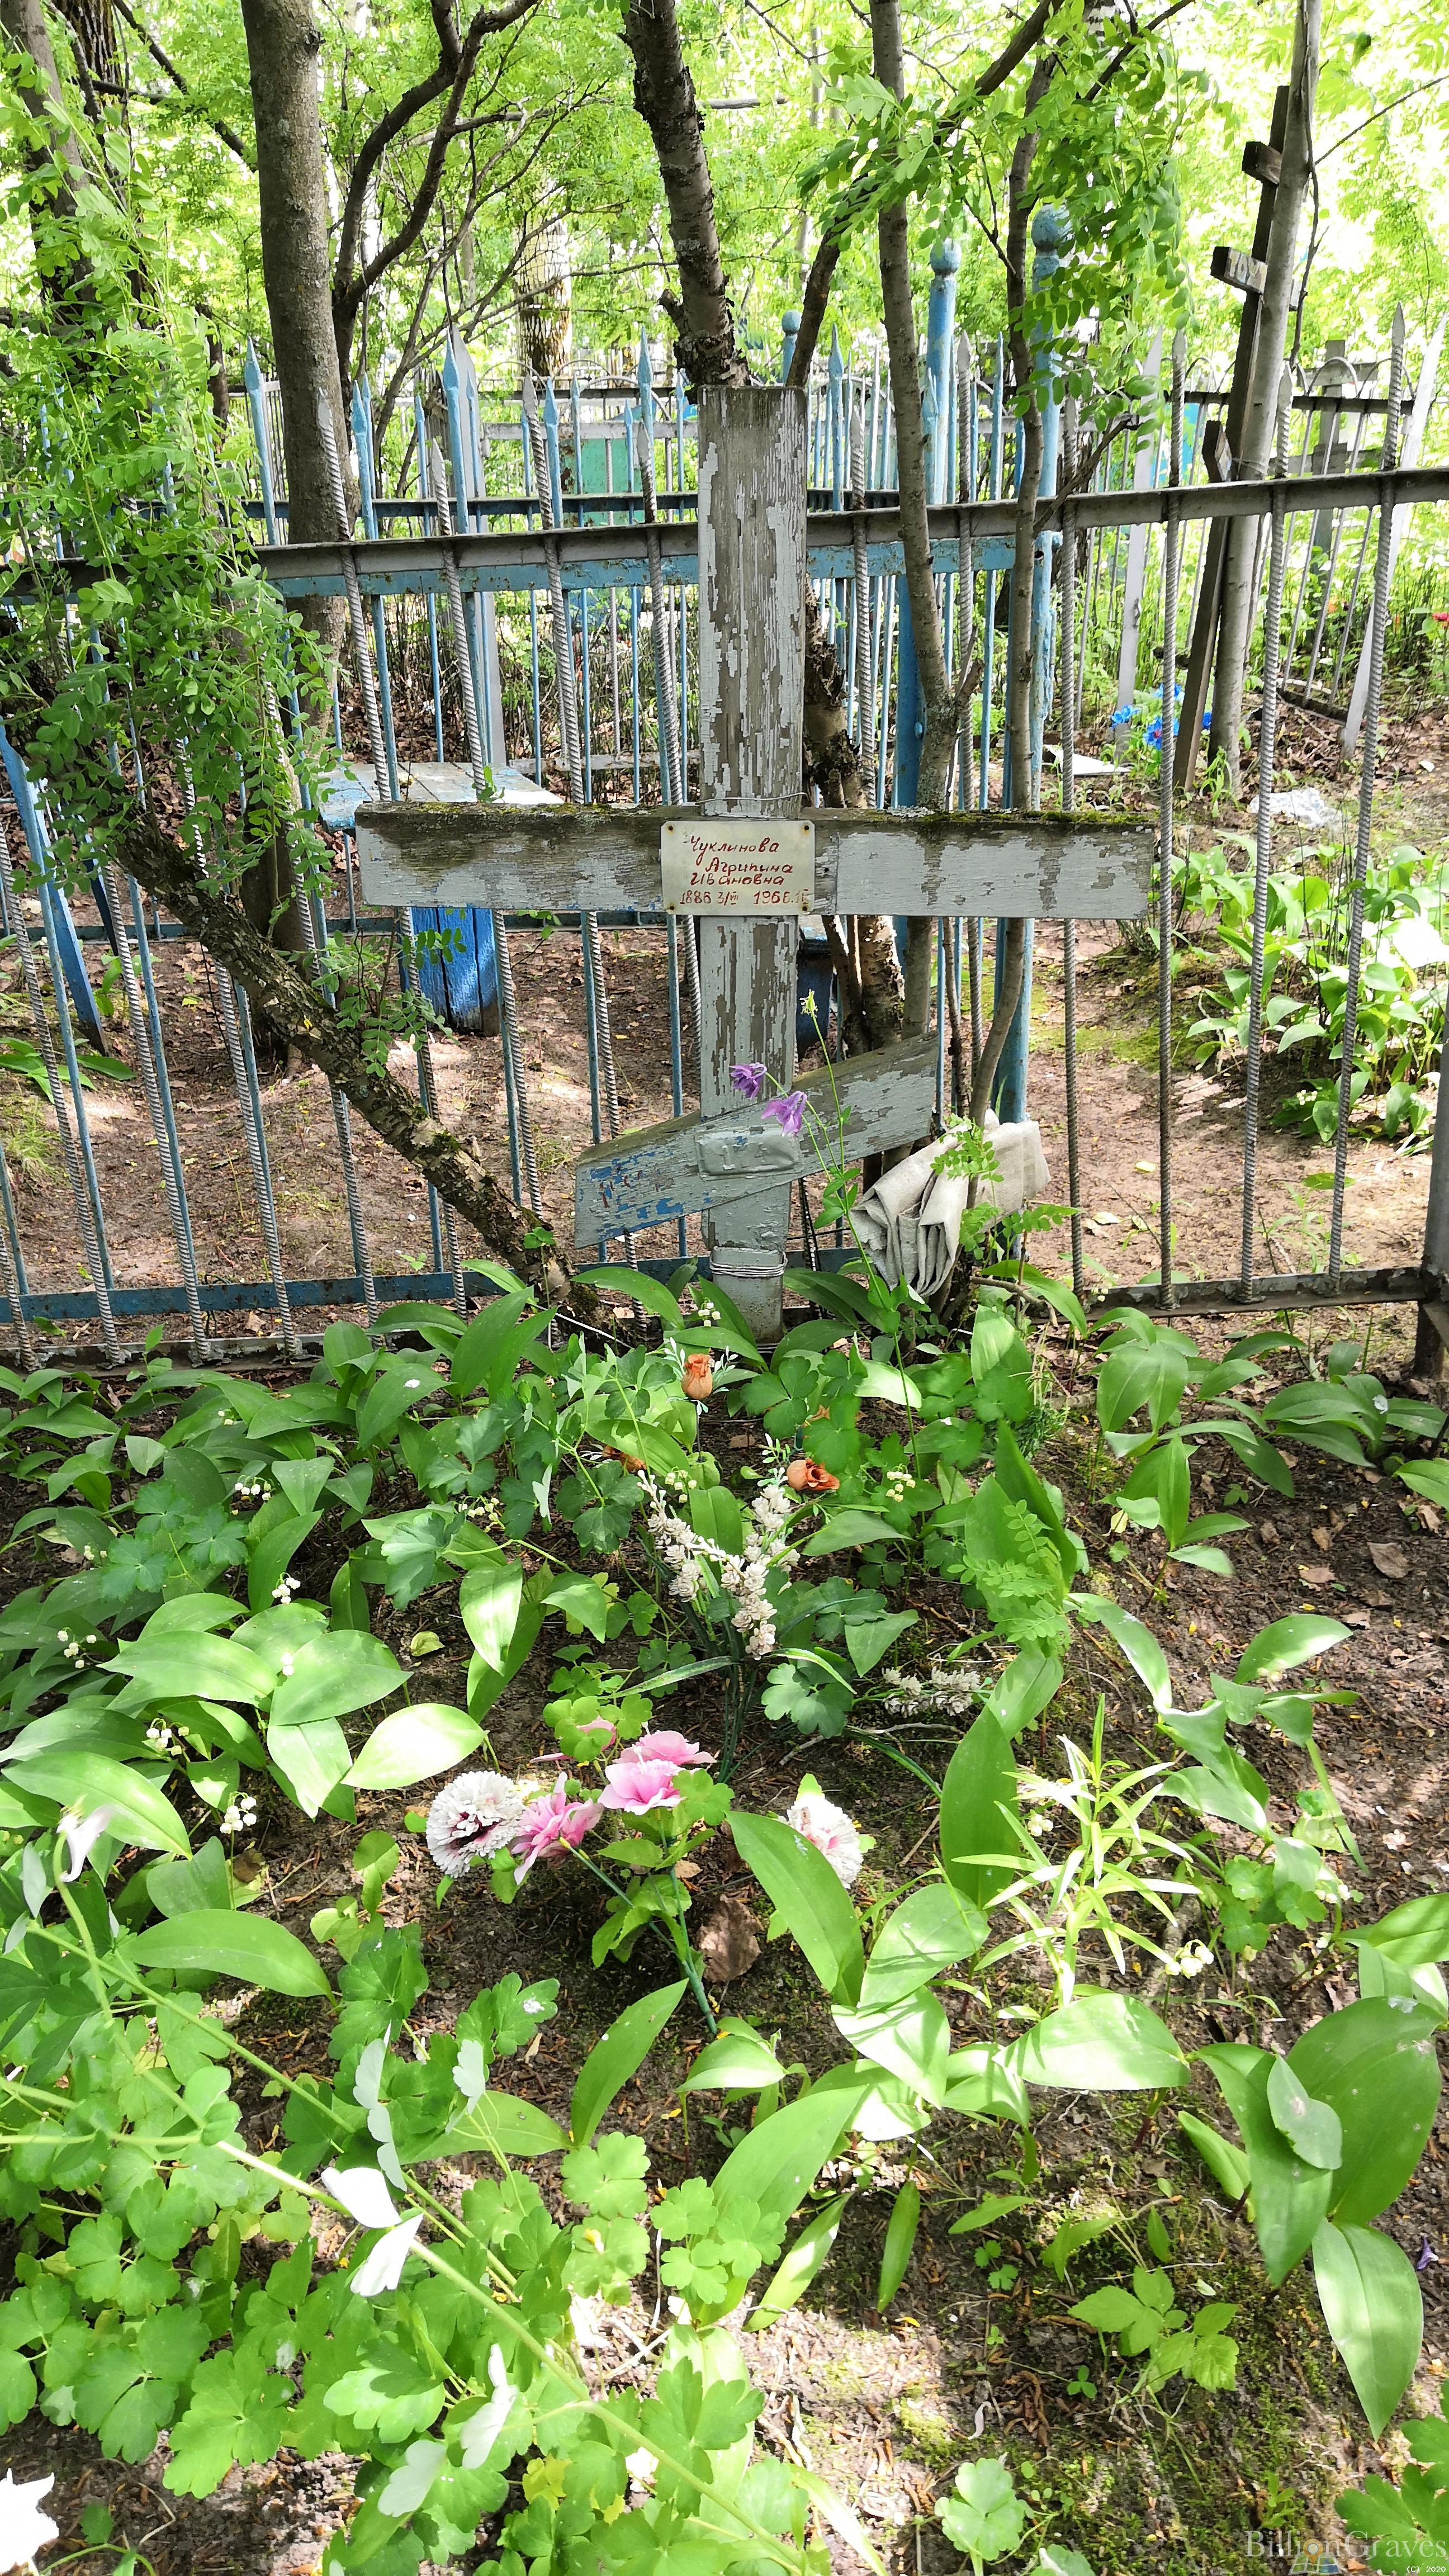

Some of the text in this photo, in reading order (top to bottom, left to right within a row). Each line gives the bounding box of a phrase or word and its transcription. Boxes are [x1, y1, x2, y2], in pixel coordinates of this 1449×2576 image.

[690, 835, 779, 866] Чуклинова
[705, 857, 793, 876] Агрипина
[690, 872, 785, 886] Ивановна
[680, 890, 712, 904] 1886
